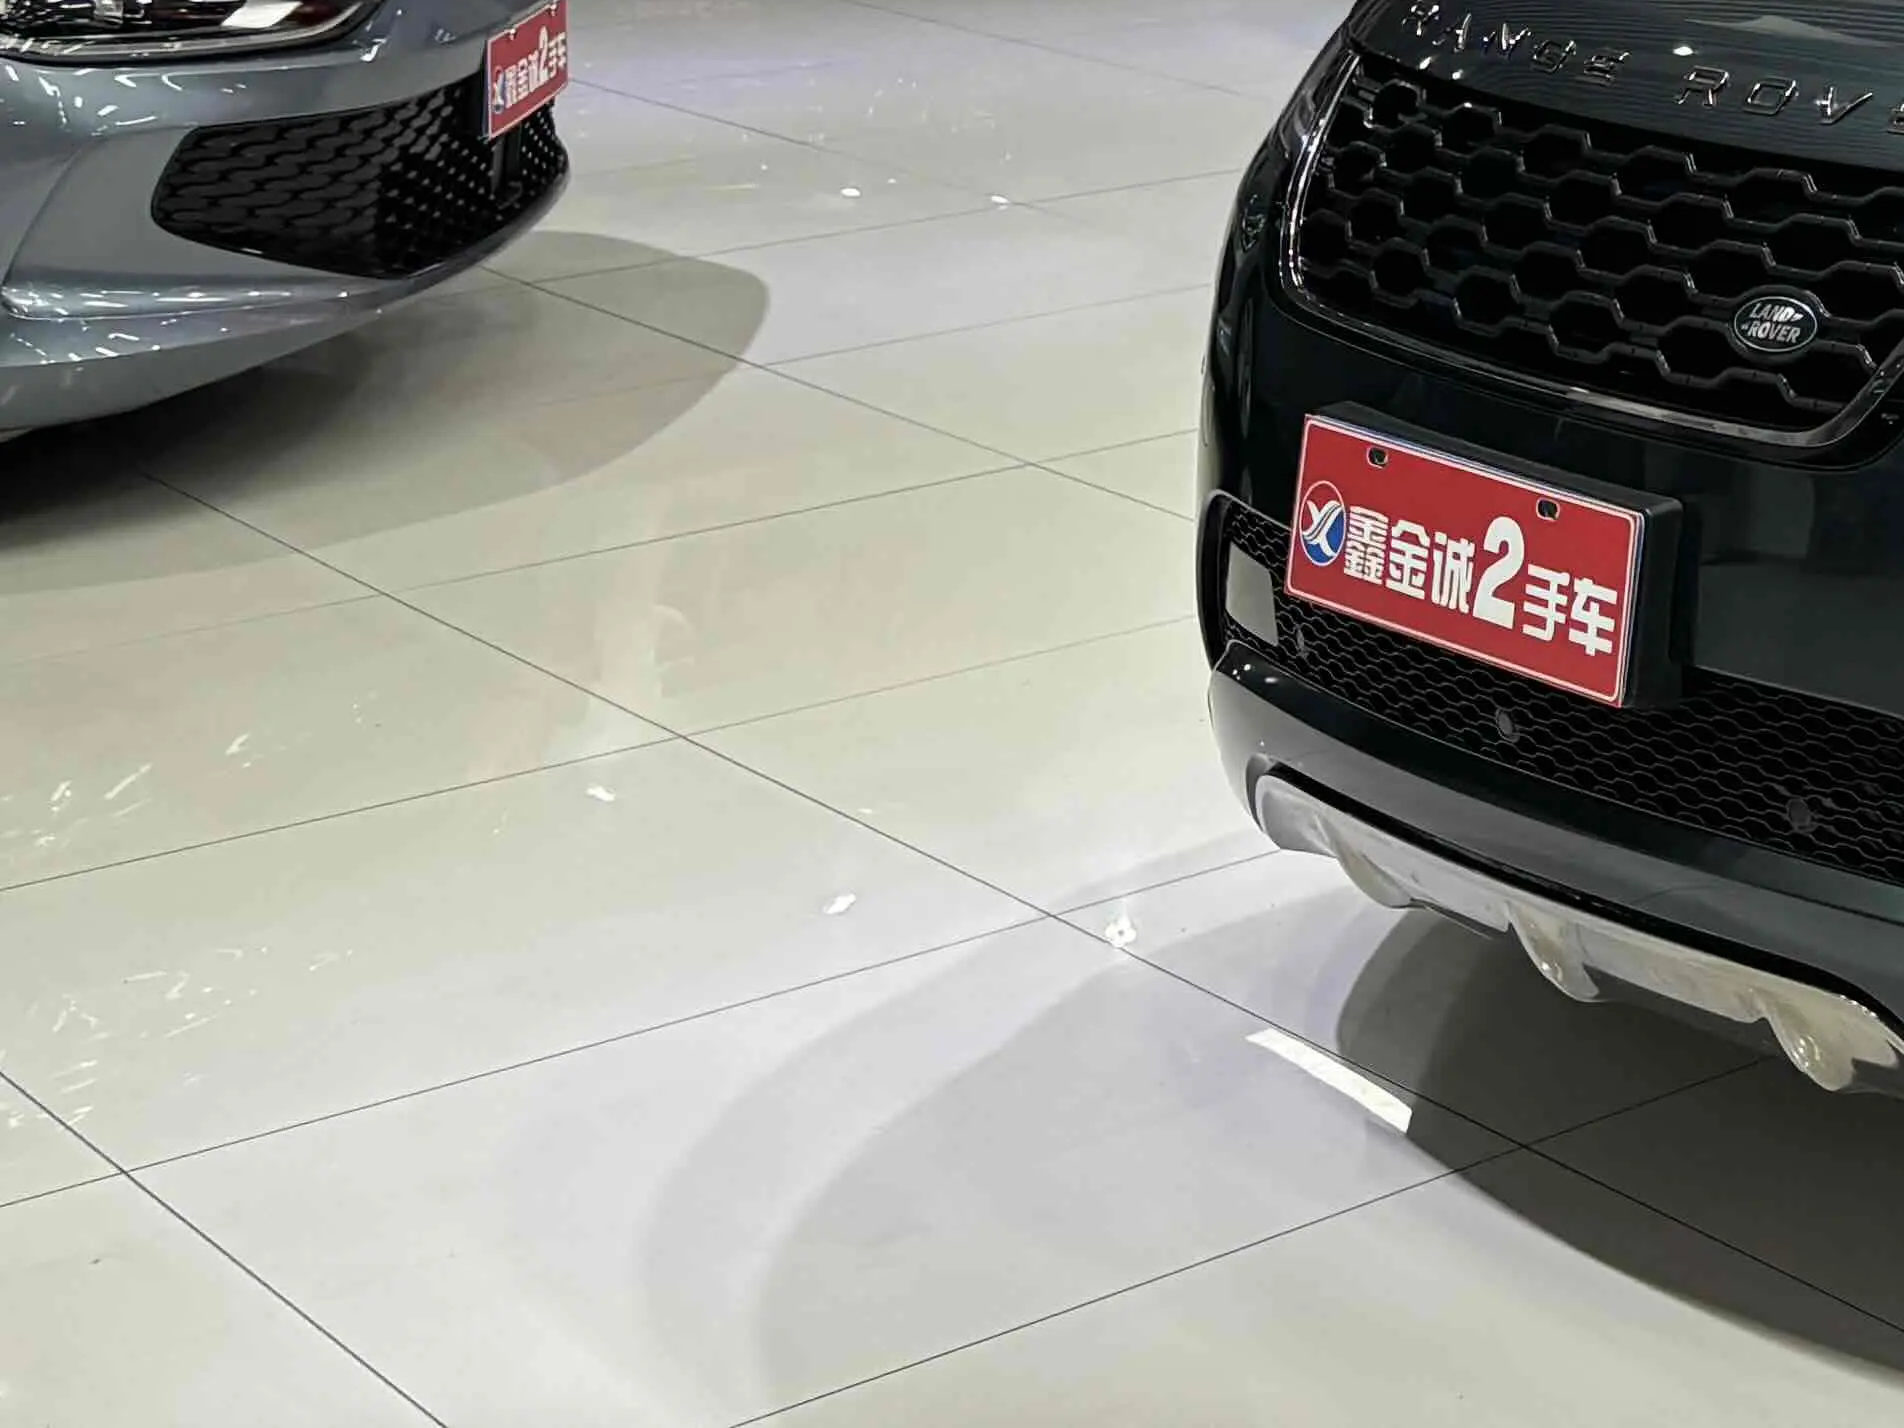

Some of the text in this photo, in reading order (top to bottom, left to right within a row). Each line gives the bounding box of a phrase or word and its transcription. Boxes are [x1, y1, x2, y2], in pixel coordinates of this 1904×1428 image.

[1750, 302, 1795, 322] LAND
[1747, 320, 1801, 343] ROVER
[1343, 505, 1618, 657] 鑫金诚2手车
